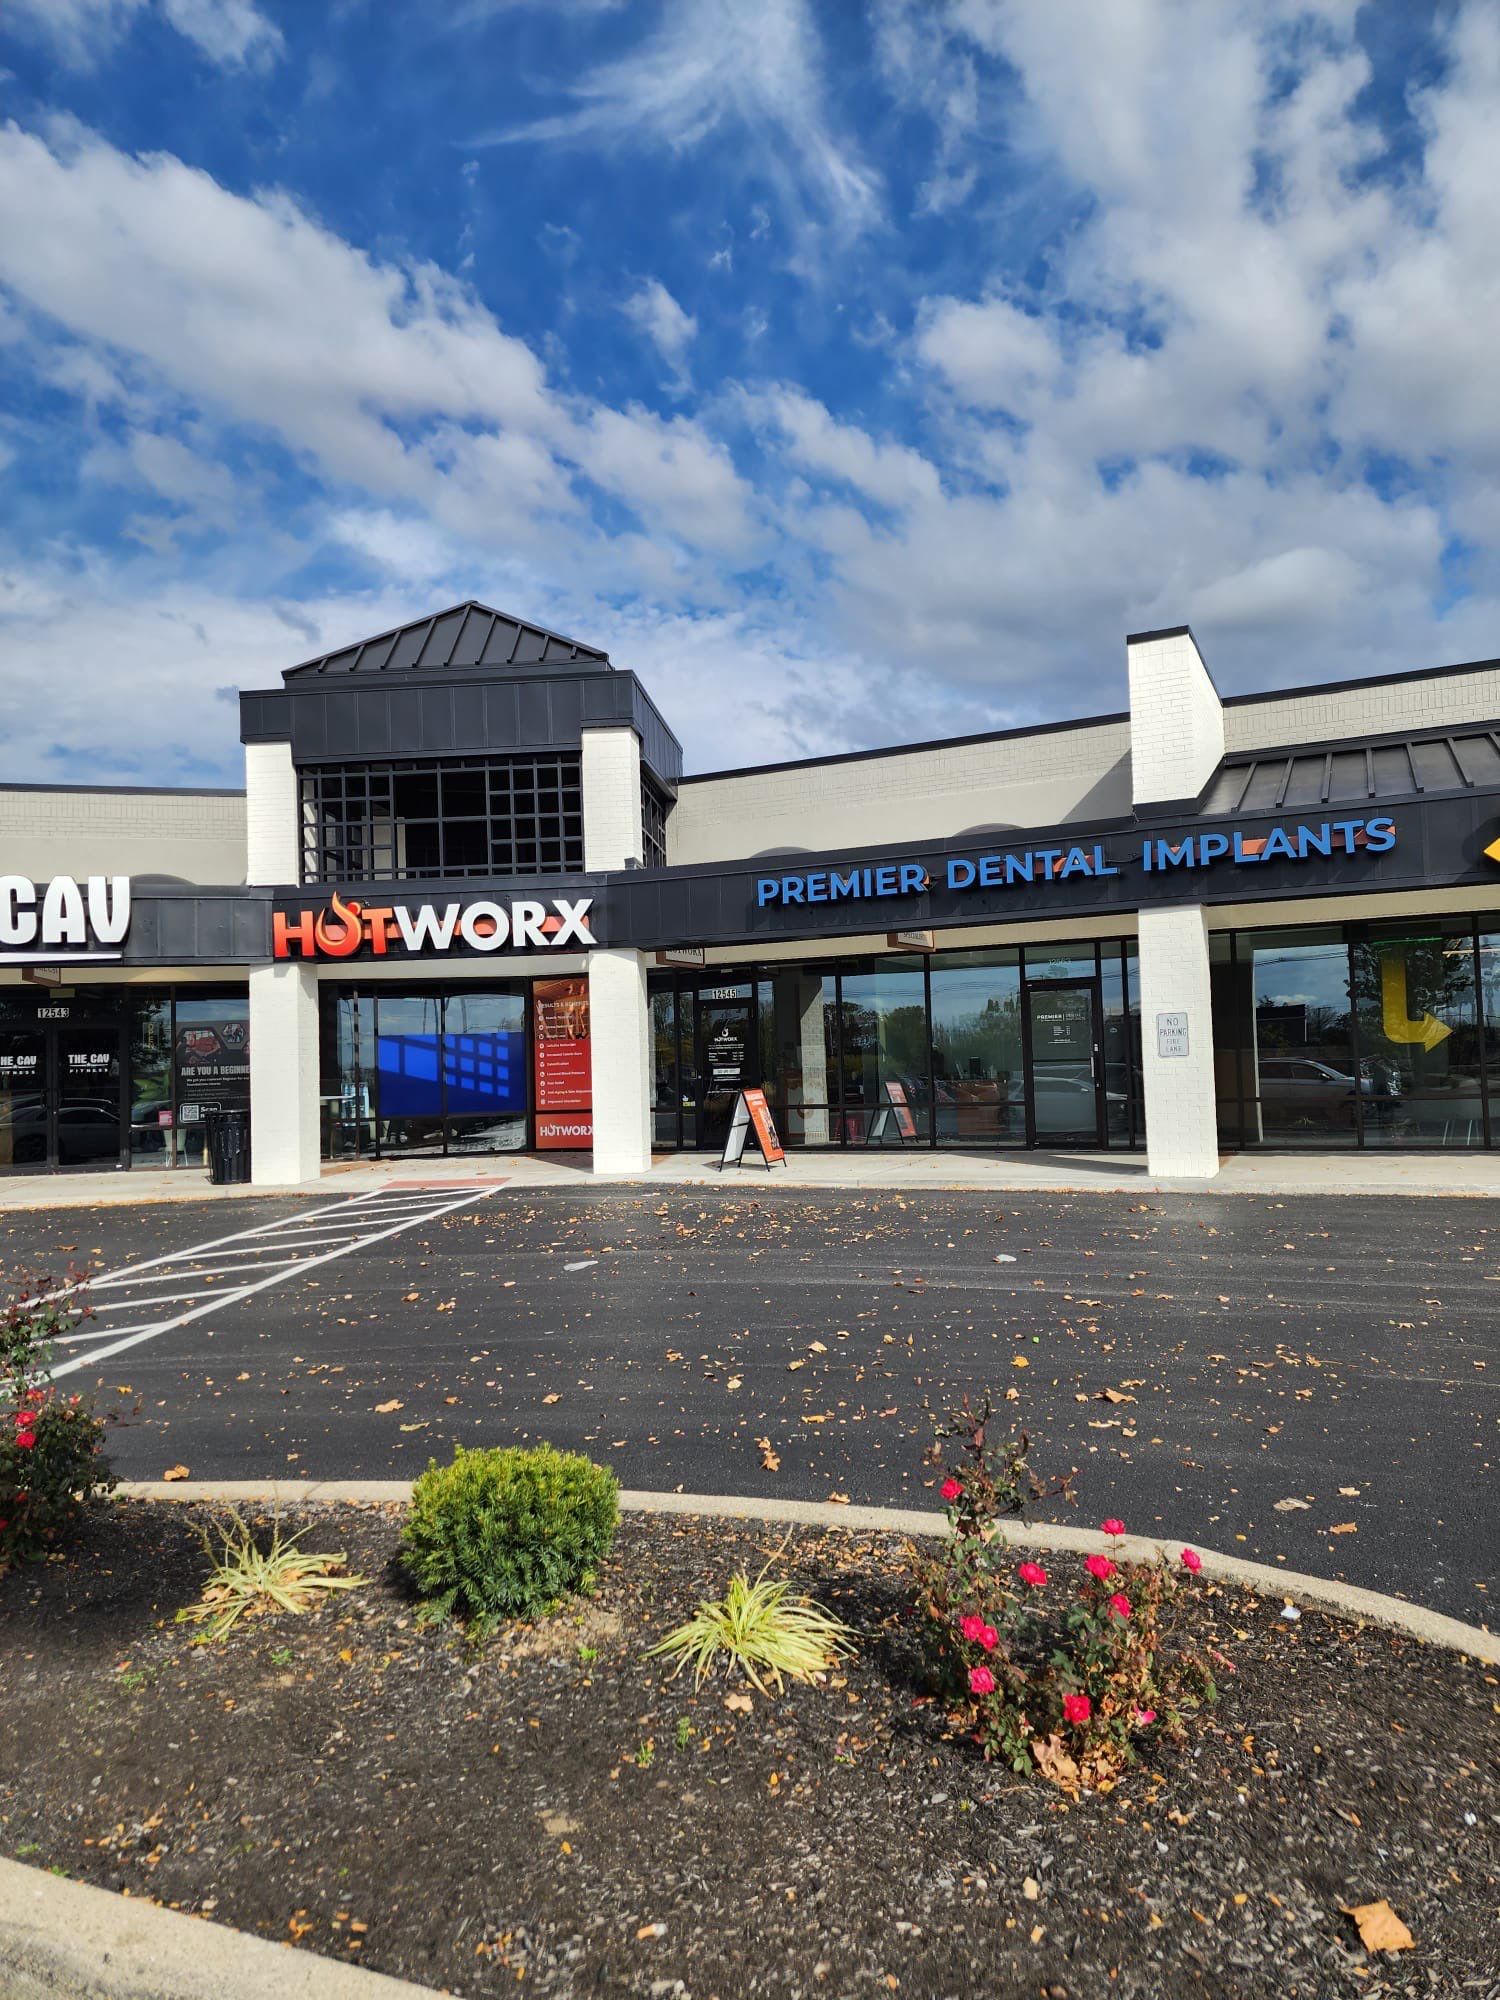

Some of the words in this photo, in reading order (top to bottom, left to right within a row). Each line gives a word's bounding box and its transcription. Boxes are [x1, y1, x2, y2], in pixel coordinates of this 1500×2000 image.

[757, 864, 928, 907] PREMIER
[947, 845, 1119, 889] DENTAL
[1143, 817, 1396, 872] IMPLANTS
[0, 875, 130, 944] CAV
[272, 890, 599, 958] HOTWORX
[713, 988, 736, 999] 12545
[38, 1008, 69, 1018] 12543
[1166, 1017, 1179, 1026] NO
[1159, 1028, 1187, 1037] PARKING
[0, 1055, 14, 1066] HE
[16, 1055, 37, 1066] CAV
[67, 1053, 88, 1064] THE
[90, 1053, 110, 1064] CAV
[181, 1066, 196, 1076] ARE
[197, 1066, 212, 1076] YOU
[213, 1066, 219, 1075] A
[220, 1064, 250, 1075] BEGINNE
